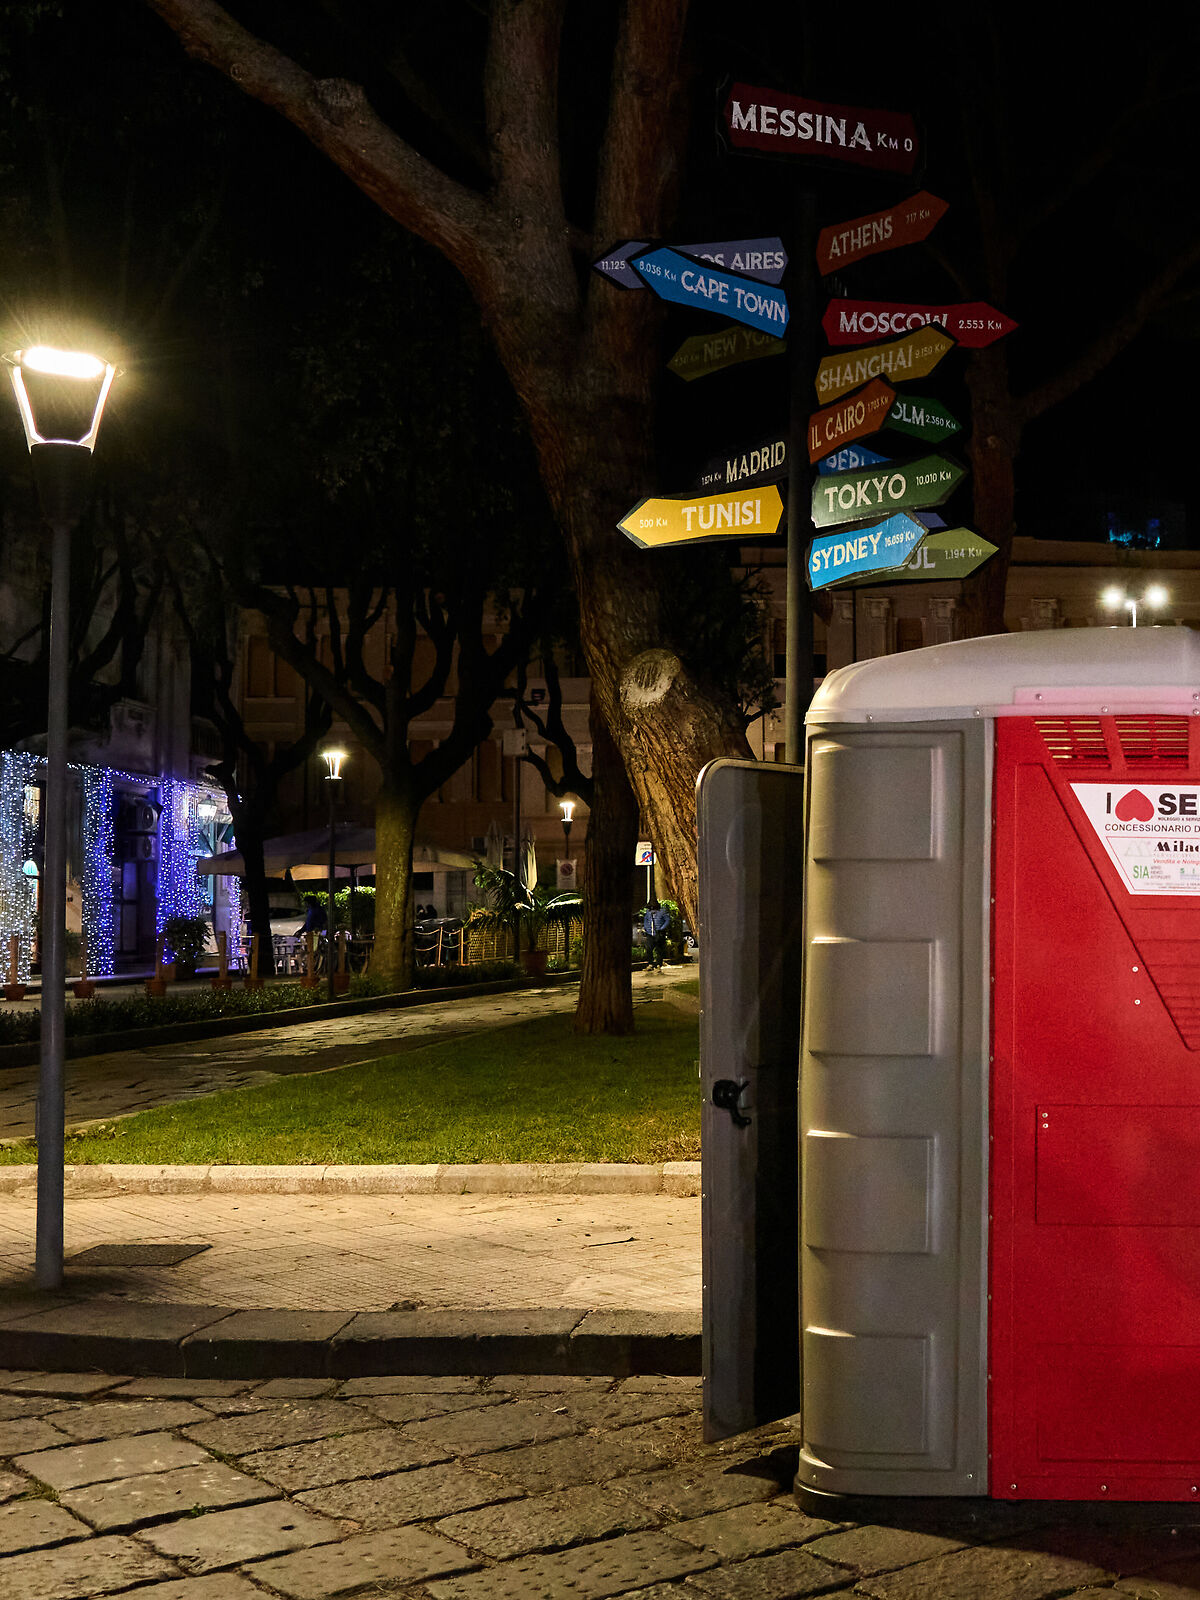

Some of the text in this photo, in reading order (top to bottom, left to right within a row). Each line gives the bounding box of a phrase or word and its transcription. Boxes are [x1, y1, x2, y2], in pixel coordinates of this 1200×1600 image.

[731, 101, 873, 151] MESSINA
[903, 138, 913, 152] 0
[829, 215, 894, 260] ATHENS
[601, 260, 626, 270] 11.125
[731, 252, 785, 271] AIRES
[639, 260, 661, 276] 8.036
[680, 270, 730, 304] CAPE
[734, 288, 786, 324] TOWN
[839, 311, 950, 334] MOSCOW
[958, 319, 985, 330] 2.553
[703, 334, 737, 363] NEW
[742, 329, 777, 351] YO
[819, 344, 913, 392] SHANGHAI
[811, 424, 822, 450] IL
[825, 401, 866, 441] CAIRO
[726, 440, 786, 484] MADRID
[824, 473, 907, 513] TOKYO
[916, 474, 938, 487] 10.010
[639, 518, 654, 529] 500
[681, 499, 761, 532] TUNISI
[812, 531, 883, 573] SYDNEY
[945, 548, 965, 560] 1.194
[1106, 792, 1112, 814] I
[1105, 823, 1191, 833] CONCESSIONARIO
[1133, 865, 1150, 879] SIA
